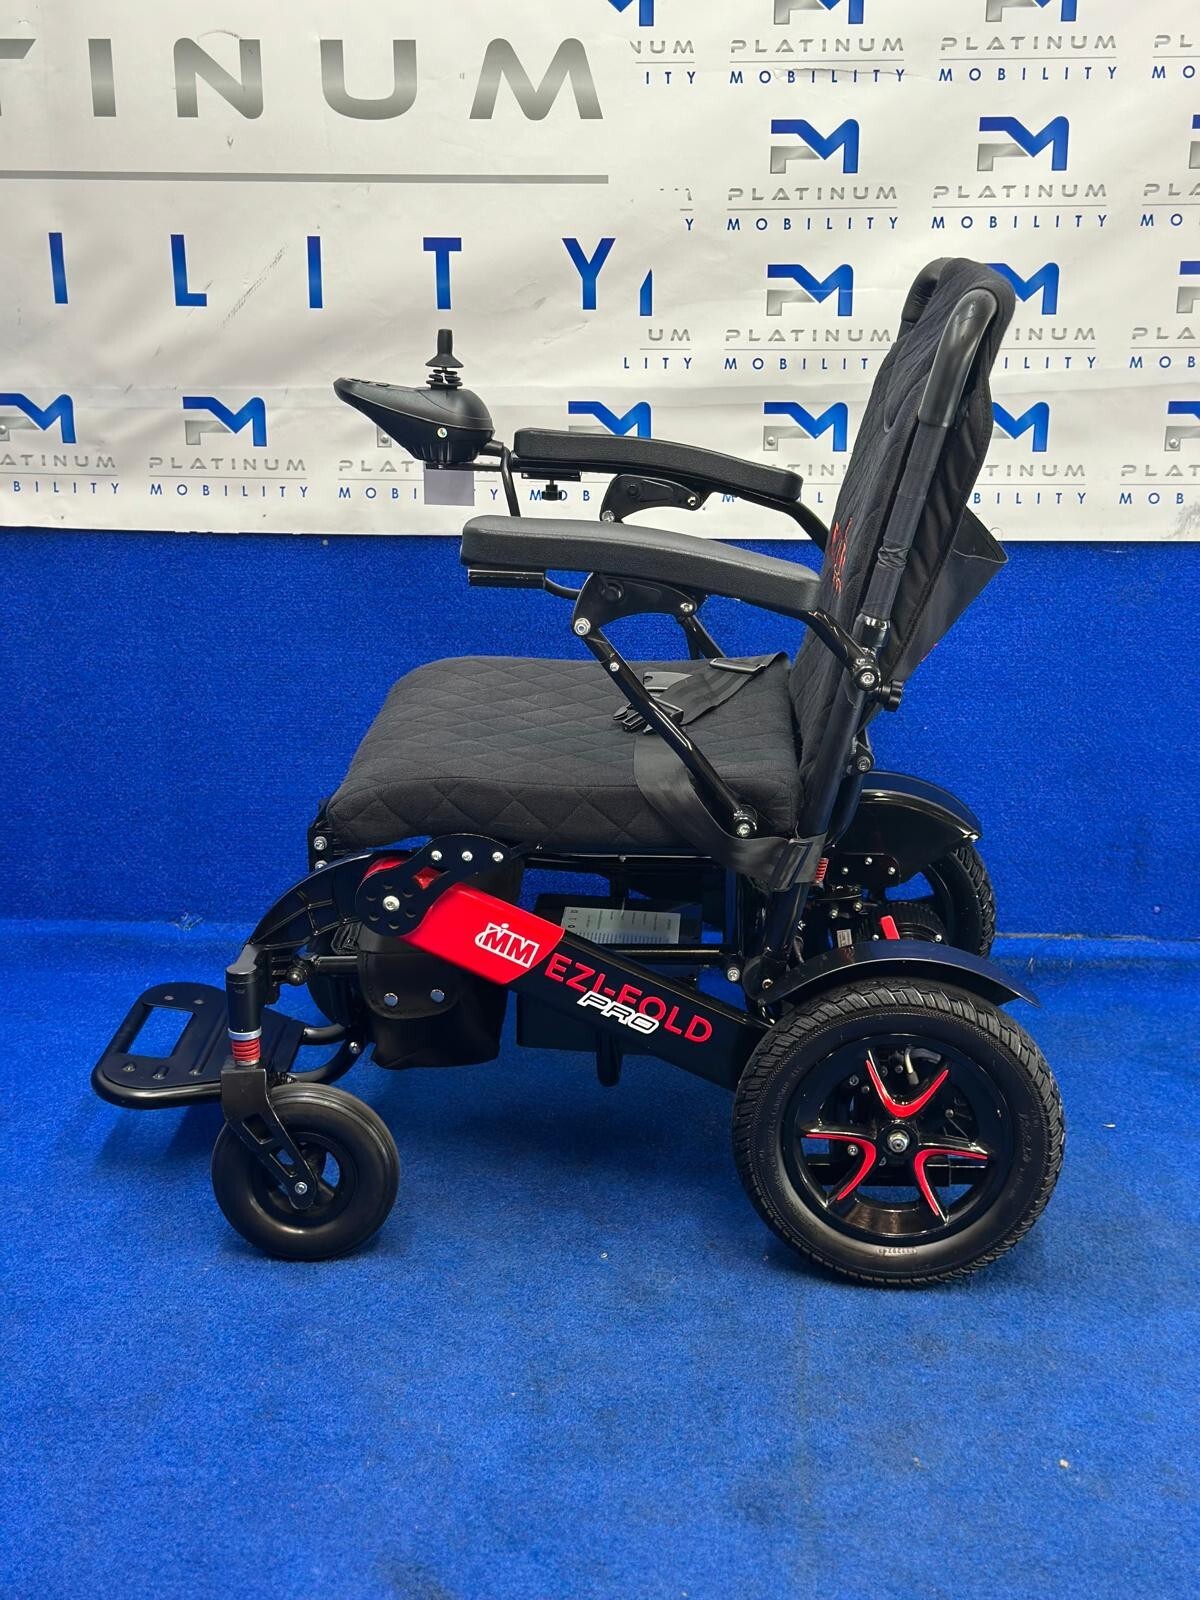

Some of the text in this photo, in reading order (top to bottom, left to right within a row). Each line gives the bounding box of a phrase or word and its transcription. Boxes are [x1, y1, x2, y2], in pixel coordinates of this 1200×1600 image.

[731, 38, 904, 53] PLATINUM
[941, 35, 1116, 50] PLATINUM
[730, 69, 905, 84] MOBILITY
[938, 66, 1117, 81] MOBILITY
[728, 187, 897, 201] PLATINUM
[933, 184, 1107, 198] PLATINUM
[727, 215, 898, 231] MOBILITY
[931, 215, 1107, 229] MOBILITY
[725, 328, 891, 342] PLATINUM
[150, 457, 306, 471] PLATINUM
[150, 484, 308, 498] MOBILITY
[544, 952, 712, 1043] EZI-FOLD
[577, 990, 660, 1035] PRO
